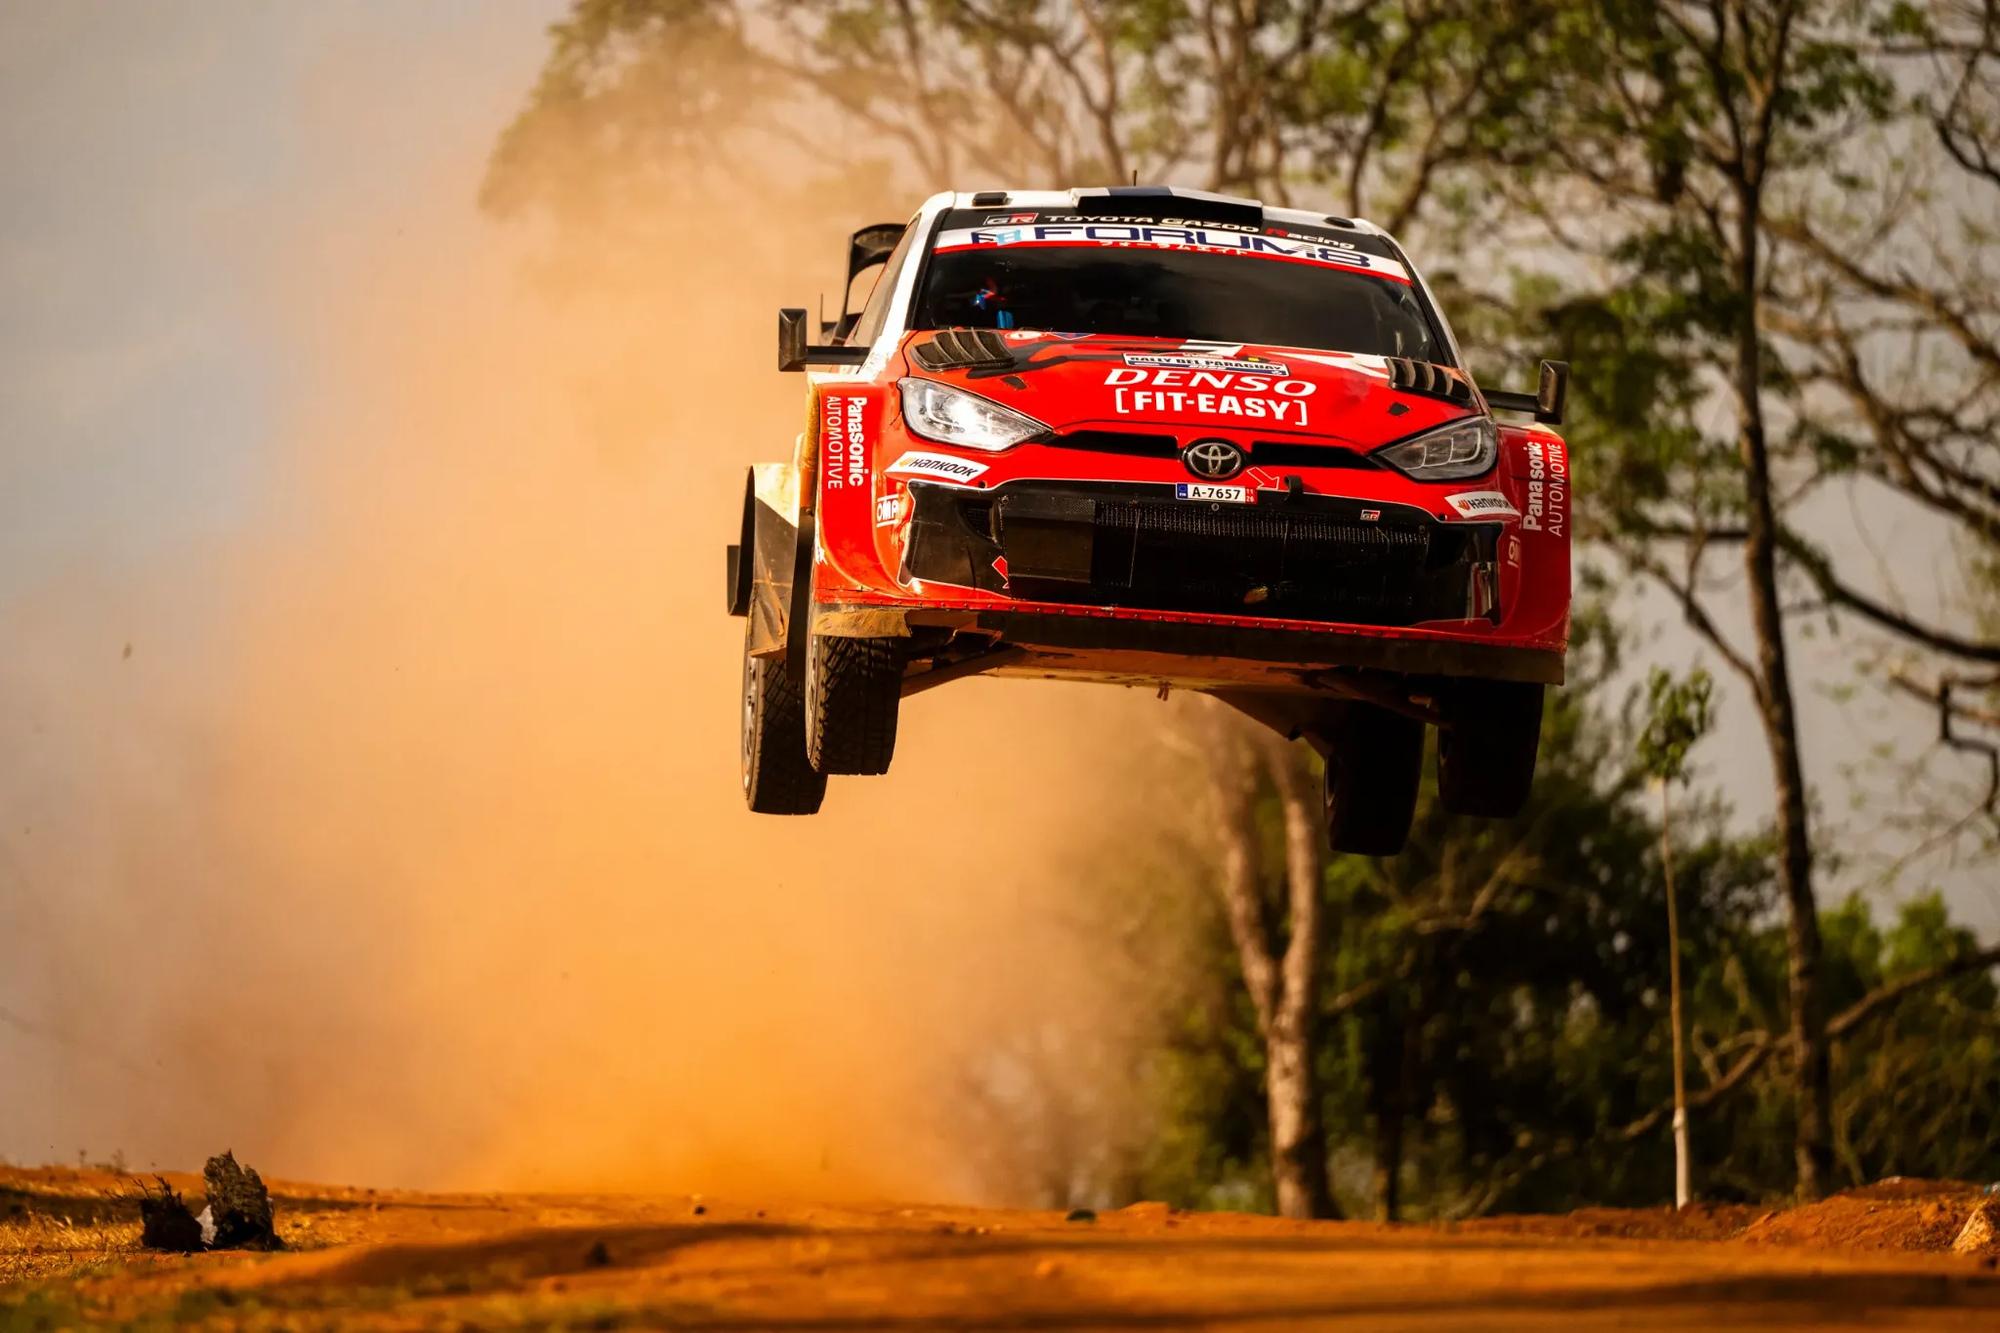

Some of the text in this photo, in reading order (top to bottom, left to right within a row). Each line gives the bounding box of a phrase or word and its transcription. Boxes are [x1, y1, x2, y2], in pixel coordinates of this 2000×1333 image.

[985, 214, 1356, 250] GR TOYOTA GAZOO Racing
[1034, 226, 1371, 268] FORUM8
[1103, 368, 1317, 397] DENSO
[1130, 356, 1171, 364] RALLY
[1175, 358, 1200, 366] DEL
[1205, 360, 1283, 371] PARAGUAY
[826, 396, 844, 489] AUTOMOTIVE
[847, 396, 869, 487] Panasonic
[1192, 486, 1241, 500] A-7657
[1522, 441, 1545, 531] Panasonic
[1547, 442, 1565, 537] AUTOMOTIVE
